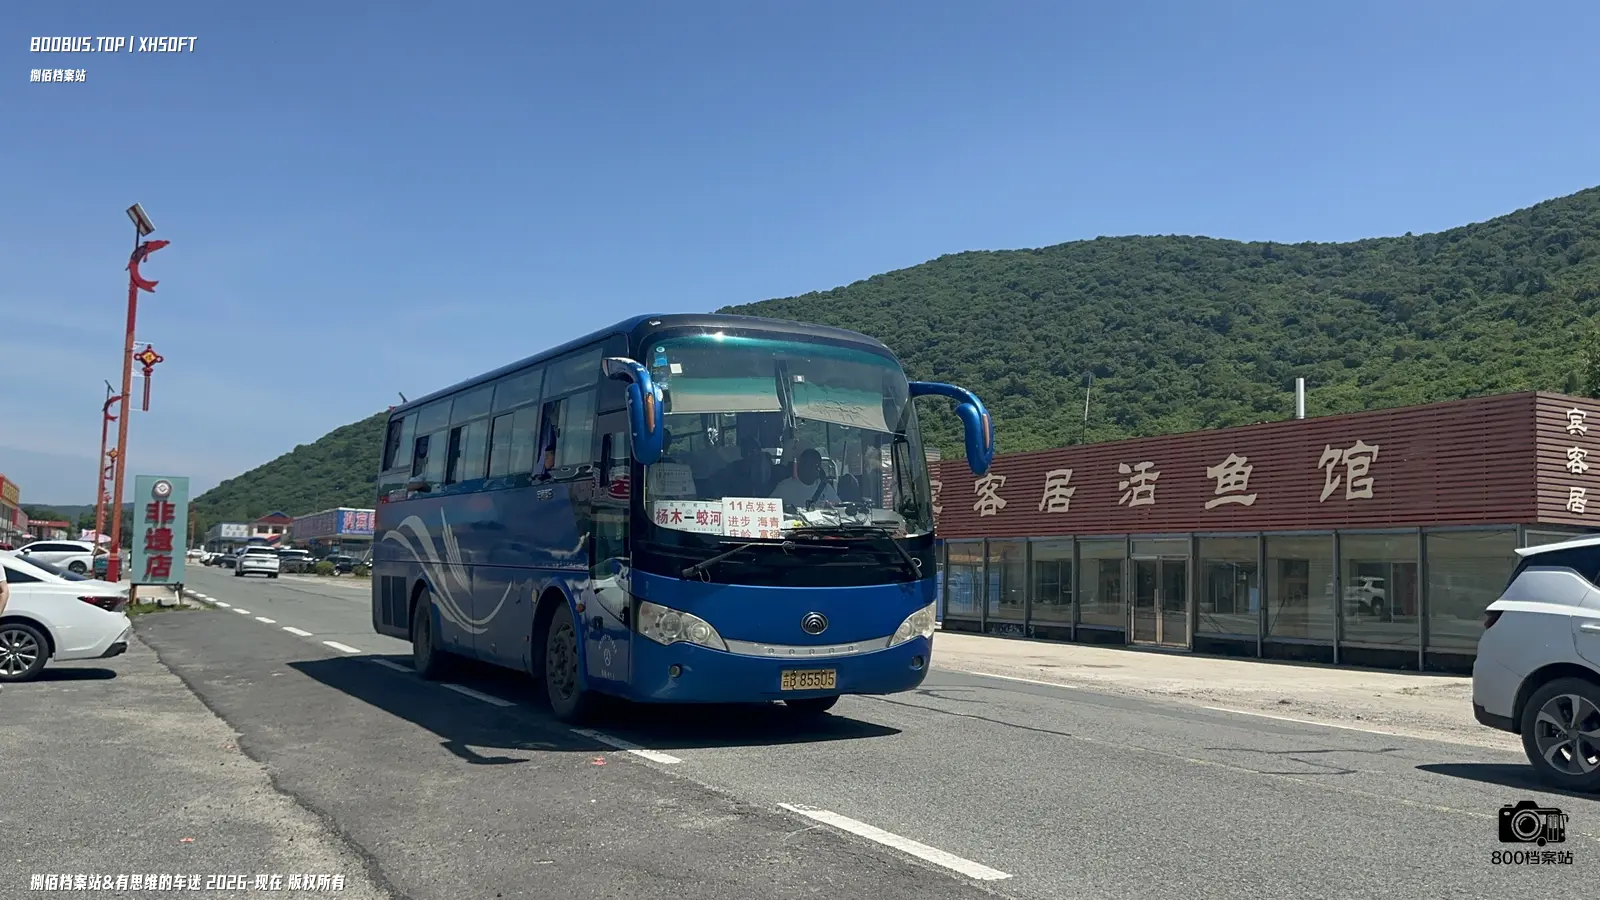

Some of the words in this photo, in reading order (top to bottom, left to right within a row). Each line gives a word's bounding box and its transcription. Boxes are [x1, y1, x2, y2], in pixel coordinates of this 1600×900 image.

[1566, 407, 1589, 514] 宾客居
[729, 501, 777, 512] 11点发车
[728, 516, 751, 527] 进步
[758, 516, 779, 528] 海青
